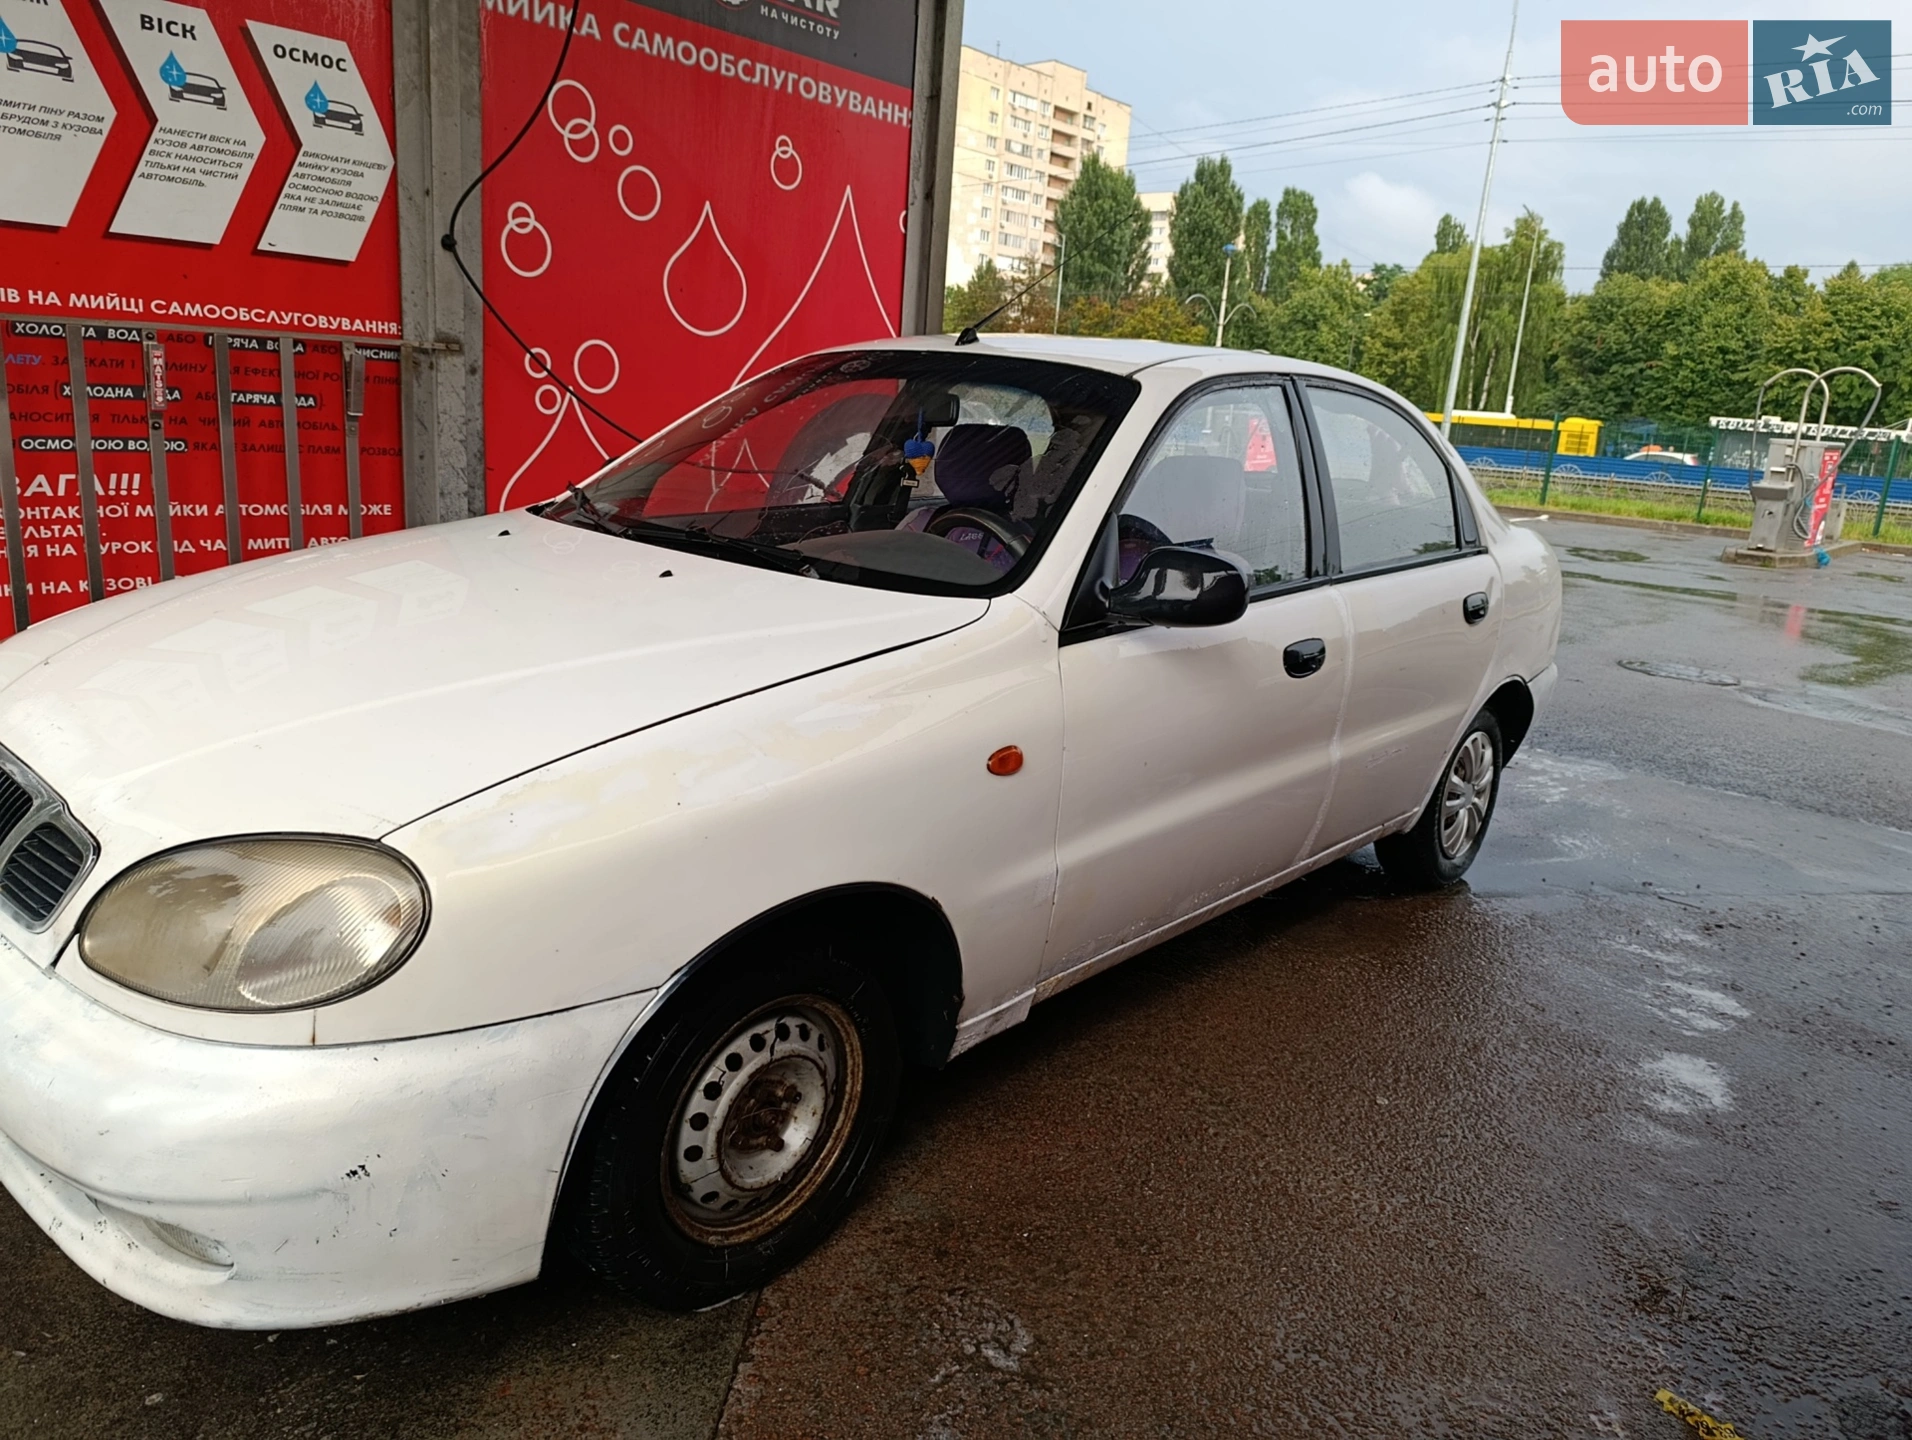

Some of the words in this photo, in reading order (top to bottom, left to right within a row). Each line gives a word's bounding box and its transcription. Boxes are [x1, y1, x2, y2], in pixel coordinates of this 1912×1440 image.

[140, 13, 197, 41] ВІСК
[272, 44, 348, 72] ОСМОС
[38, 105, 66, 116] ПІНУ
[67, 110, 105, 123] РАЗОМ
[0, 112, 50, 127] БРУДОМ
[61, 122, 104, 136] КУЗОВА
[0, 125, 62, 141] ТОМОБІЛЯ
[153, 137, 188, 149] КУЗОВ
[158, 126, 208, 140] НАНЕСТИ
[208, 134, 232, 145] ВІСК
[233, 139, 247, 147] НА
[148, 148, 173, 159] ВІСК
[174, 153, 243, 169] НАНОСИТЬСЯ
[302, 150, 351, 165] ВИКОНАТИ
[144, 160, 181, 172] ТІЛЬКИ
[182, 166, 196, 174] НА
[199, 168, 239, 180] ЧИСТИЙ
[297, 161, 330, 171] МИЙКУ
[330, 167, 365, 178] КУЗОВА
[138, 172, 207, 188] АВТОМОБІЛЬ.
[292, 172, 352, 187] АВТОМОБІЛЯ
[288, 182, 344, 197] ОСМОСНОЮ
[283, 193, 302, 202] ЯКА
[318, 198, 364, 211] ЗАЛИШАЄ
[279, 203, 306, 213] ПЛЯМ
[308, 207, 319, 216] ТА
[320, 209, 366, 222] РОЗВОДІВ.
[28, 289, 63, 307] НА
[68, 292, 144, 314] МИЙЦІ
[150, 300, 402, 336] САМООБСЛУГОВУВАННЯ:
[107, 328, 141, 342] ВОД
[165, 333, 197, 345] АБО
[208, 335, 259, 350] ГРЯЧА
[110, 413, 150, 424] ТІЛЬК
[168, 415, 188, 425] НА
[21, 438, 125, 451] ОСМООЮ
[128, 439, 189, 453] ВООЮ,
[135, 501, 209, 518] МЙКИ
[214, 504, 333, 518] АТОМОБІЛЯ
[45, 543, 78, 558] НА
[198, 539, 228, 552] ЧА
[247, 537, 291, 551] МИТТ
[41, 580, 73, 595] НА
[79, 576, 153, 593] КЗОВІ
